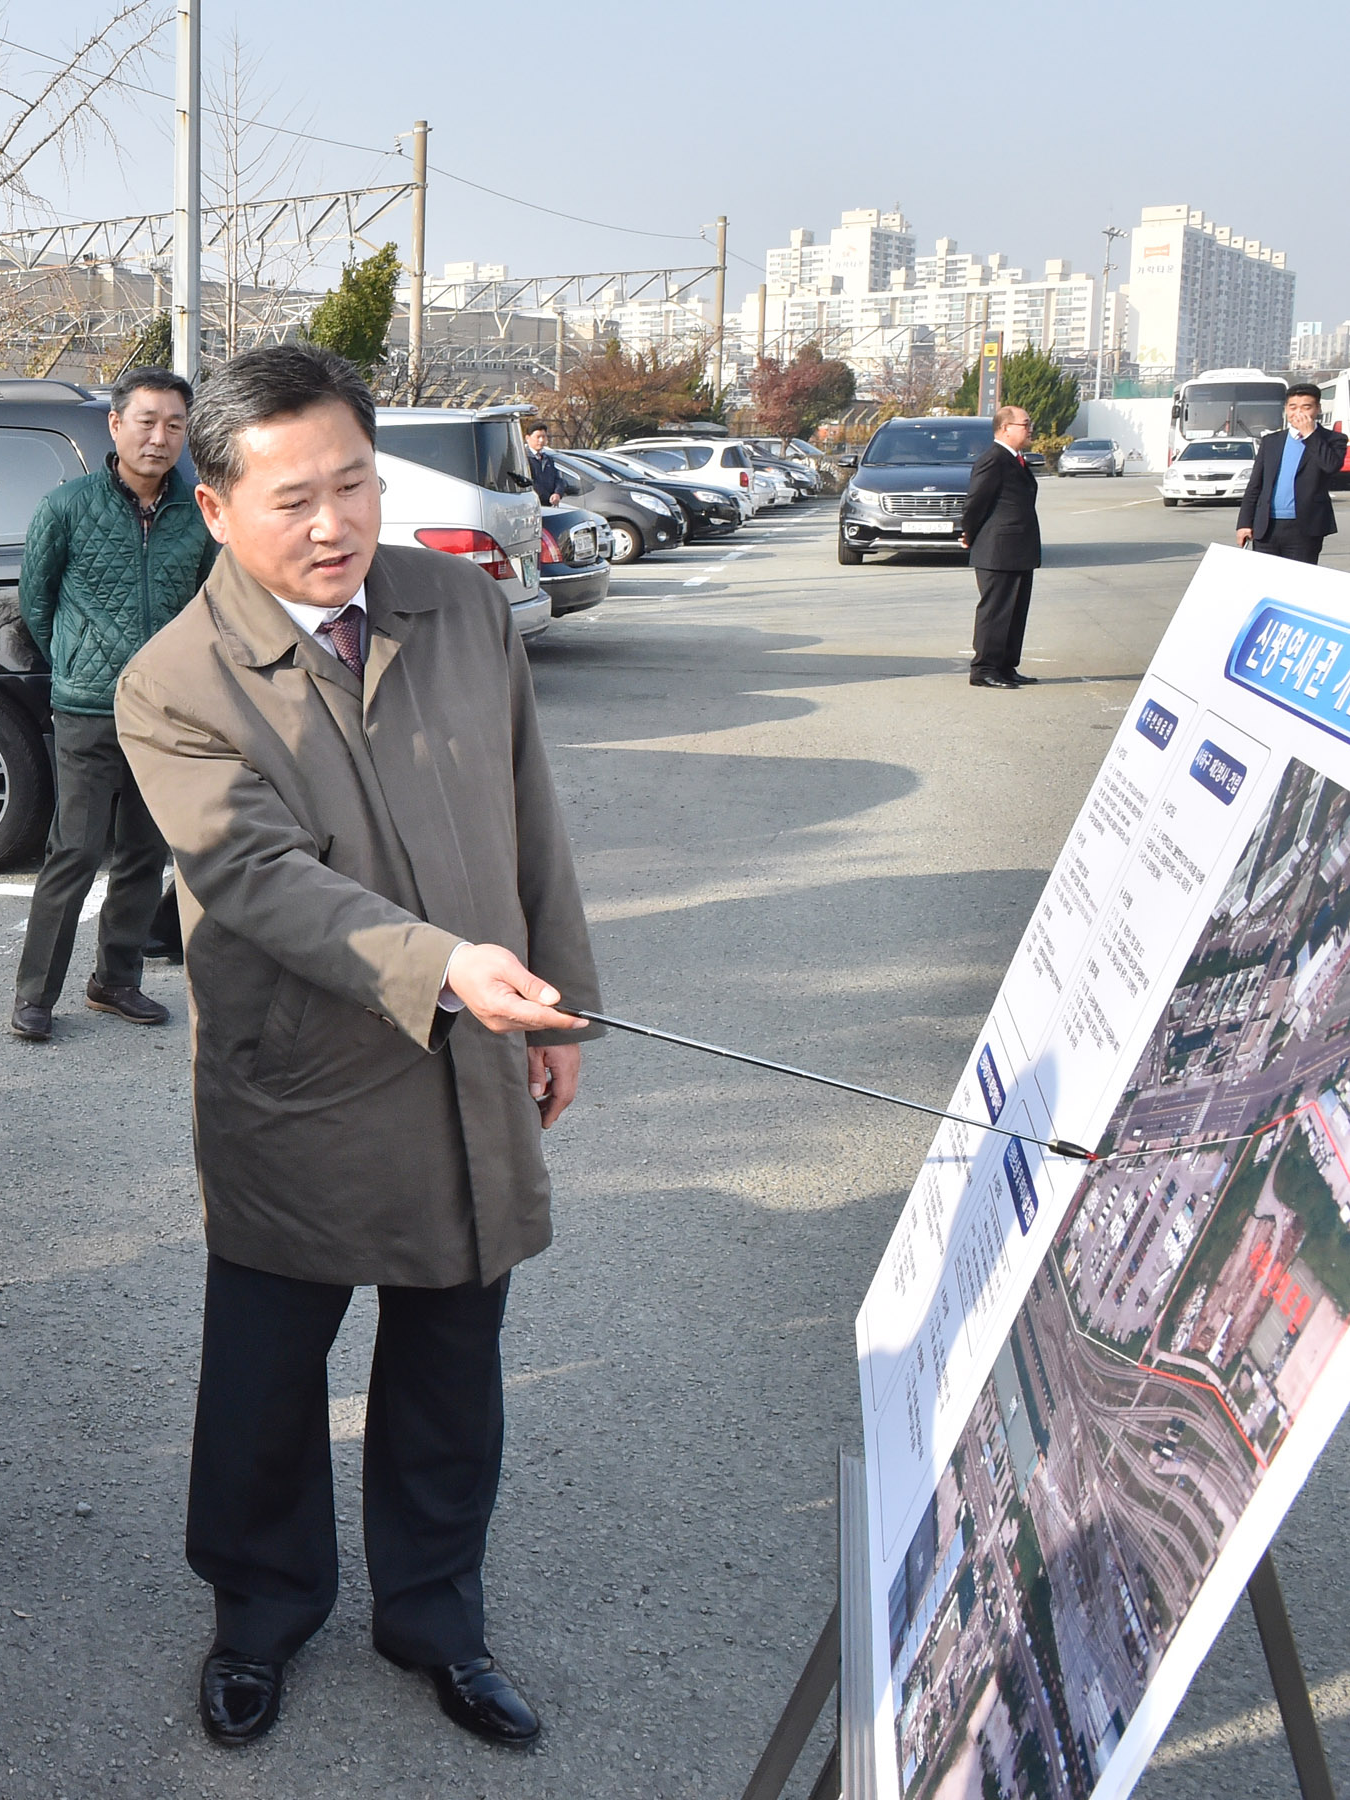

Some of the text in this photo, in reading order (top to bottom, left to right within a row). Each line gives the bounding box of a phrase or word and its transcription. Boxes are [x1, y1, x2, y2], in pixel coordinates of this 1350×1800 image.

[1137, 265, 1174, 275] 가락타운
[988, 360, 996, 372] 2
[1245, 618, 1344, 699] 신평역세권
[1140, 707, 1174, 740] 서부산의료원
[1195, 748, 1213, 771] 사하구
[1225, 771, 1243, 795] 건립
